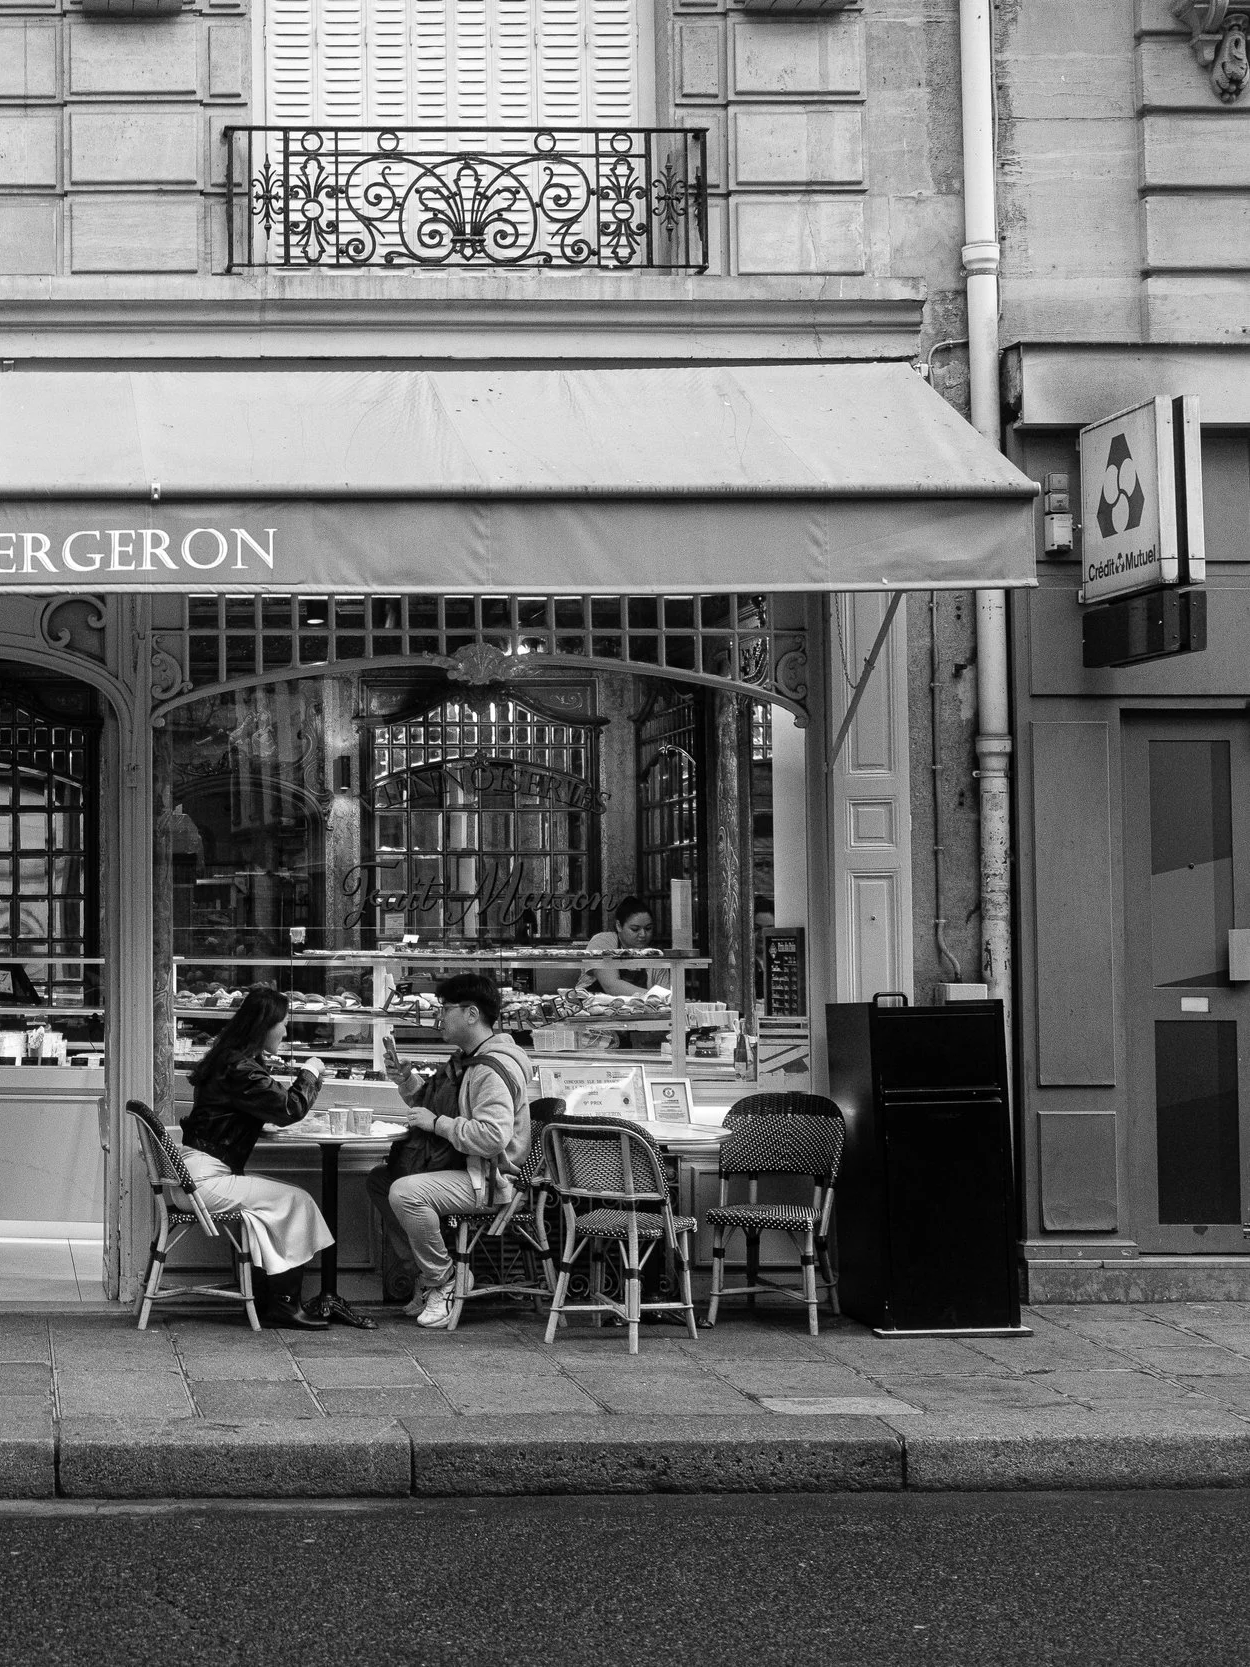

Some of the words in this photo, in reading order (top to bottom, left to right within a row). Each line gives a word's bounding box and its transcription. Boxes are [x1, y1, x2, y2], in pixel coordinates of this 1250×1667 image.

[1088, 557, 1115, 582] Crédit
[1125, 543, 1156, 571] Mutuel
[353, 766, 611, 815] VIENNOISERIES
[342, 860, 446, 930] Fait
[444, 860, 622, 927] Maison
[379, 986, 584, 1035] PAERIES
